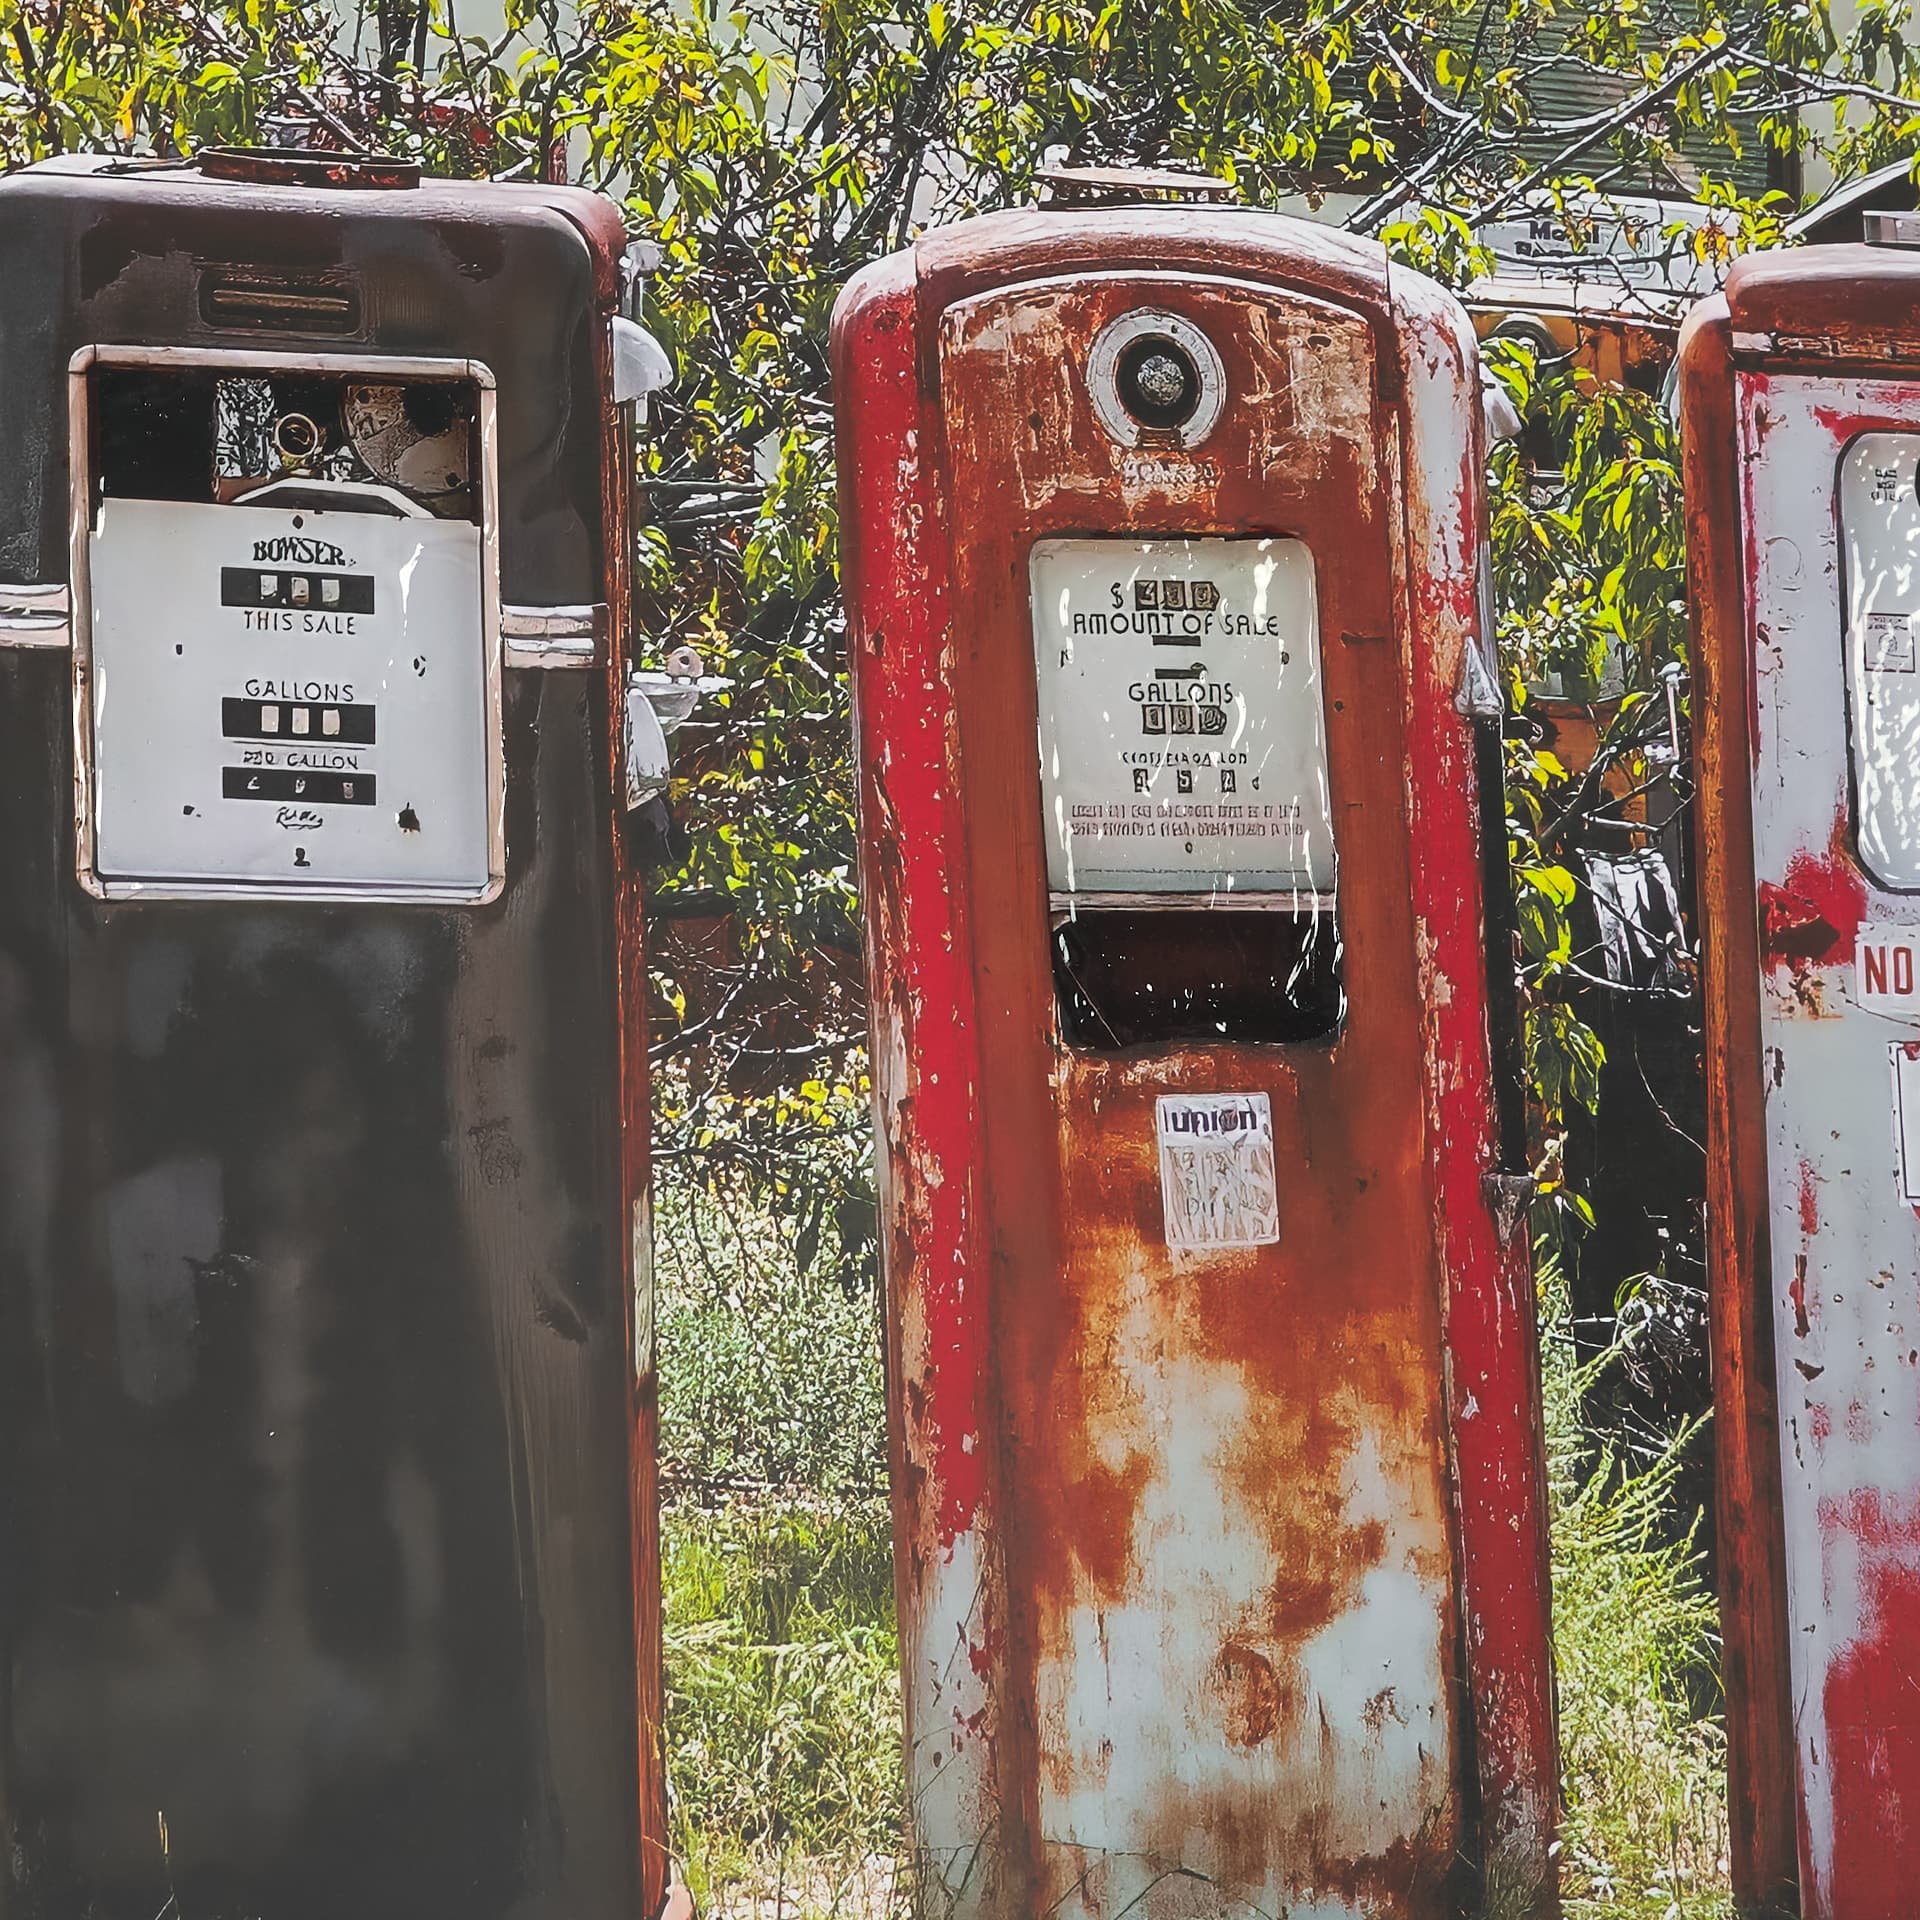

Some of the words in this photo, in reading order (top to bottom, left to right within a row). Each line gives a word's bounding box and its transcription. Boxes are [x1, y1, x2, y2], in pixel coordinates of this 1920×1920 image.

[252, 536, 346, 567] BOWSER
[244, 610, 293, 632] THIS
[303, 614, 356, 635] SALE
[1182, 613, 1214, 635] OF
[1224, 613, 1280, 636] SALE
[245, 679, 354, 702] GALLONS
[1128, 682, 1234, 704] GALLONS
[1864, 945, 1914, 995] NO
